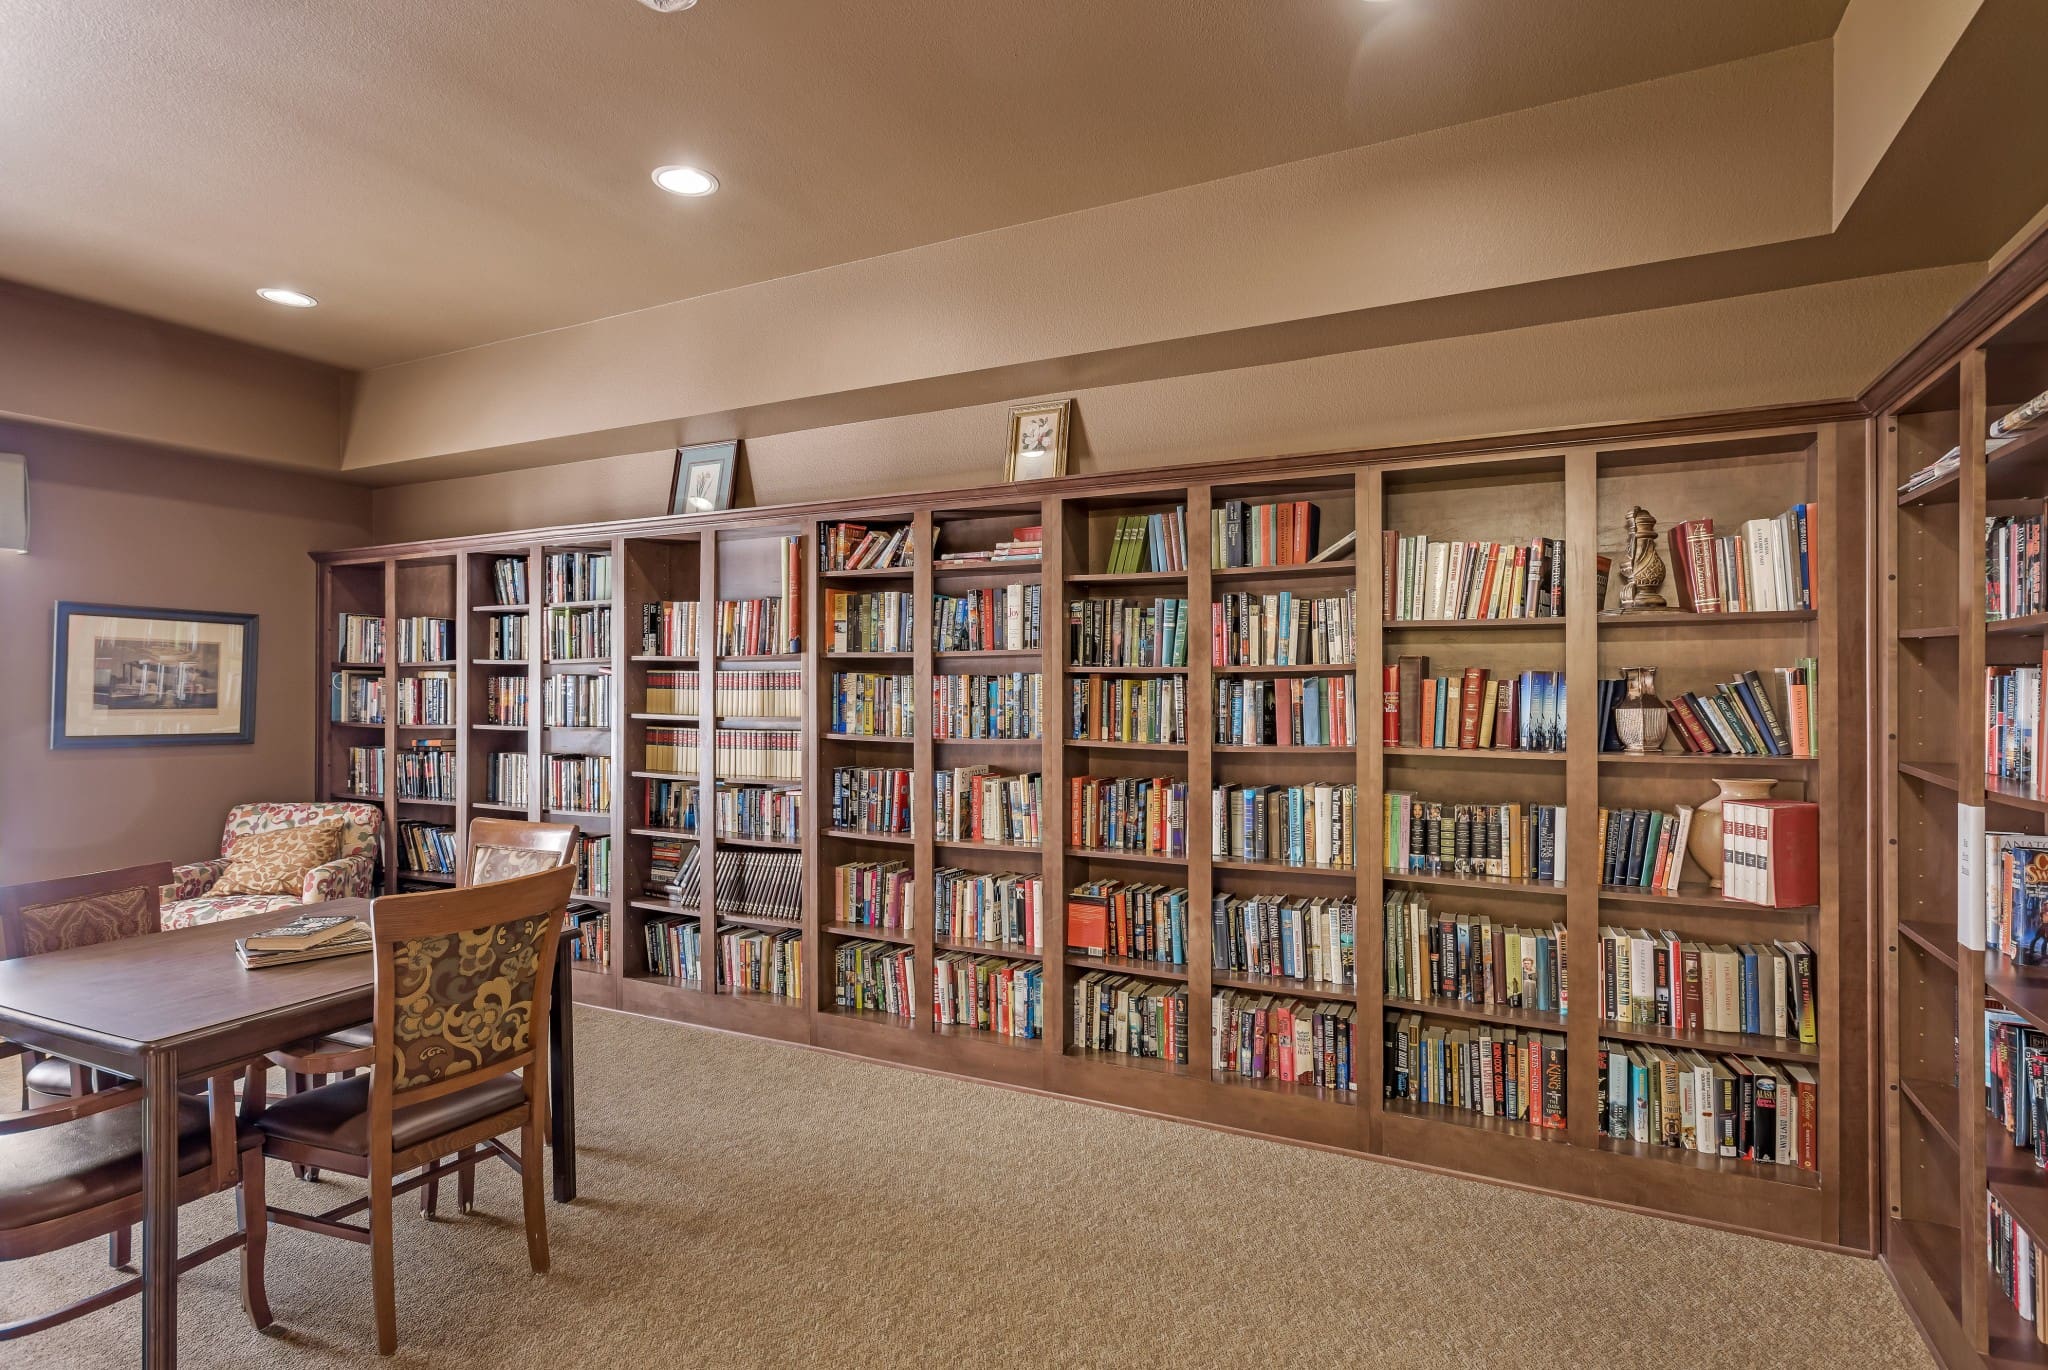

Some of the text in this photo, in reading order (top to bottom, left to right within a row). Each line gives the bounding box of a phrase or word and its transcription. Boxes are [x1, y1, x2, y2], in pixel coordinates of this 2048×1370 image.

[1446, 933, 1455, 979] MARK GREANEY
[1617, 956, 1630, 1006] ELLIS ISLAND
[1494, 1058, 1502, 1073] COOK
[1531, 1044, 1539, 1093] SECRETS CODE
[1546, 1063, 1561, 1089] KING
